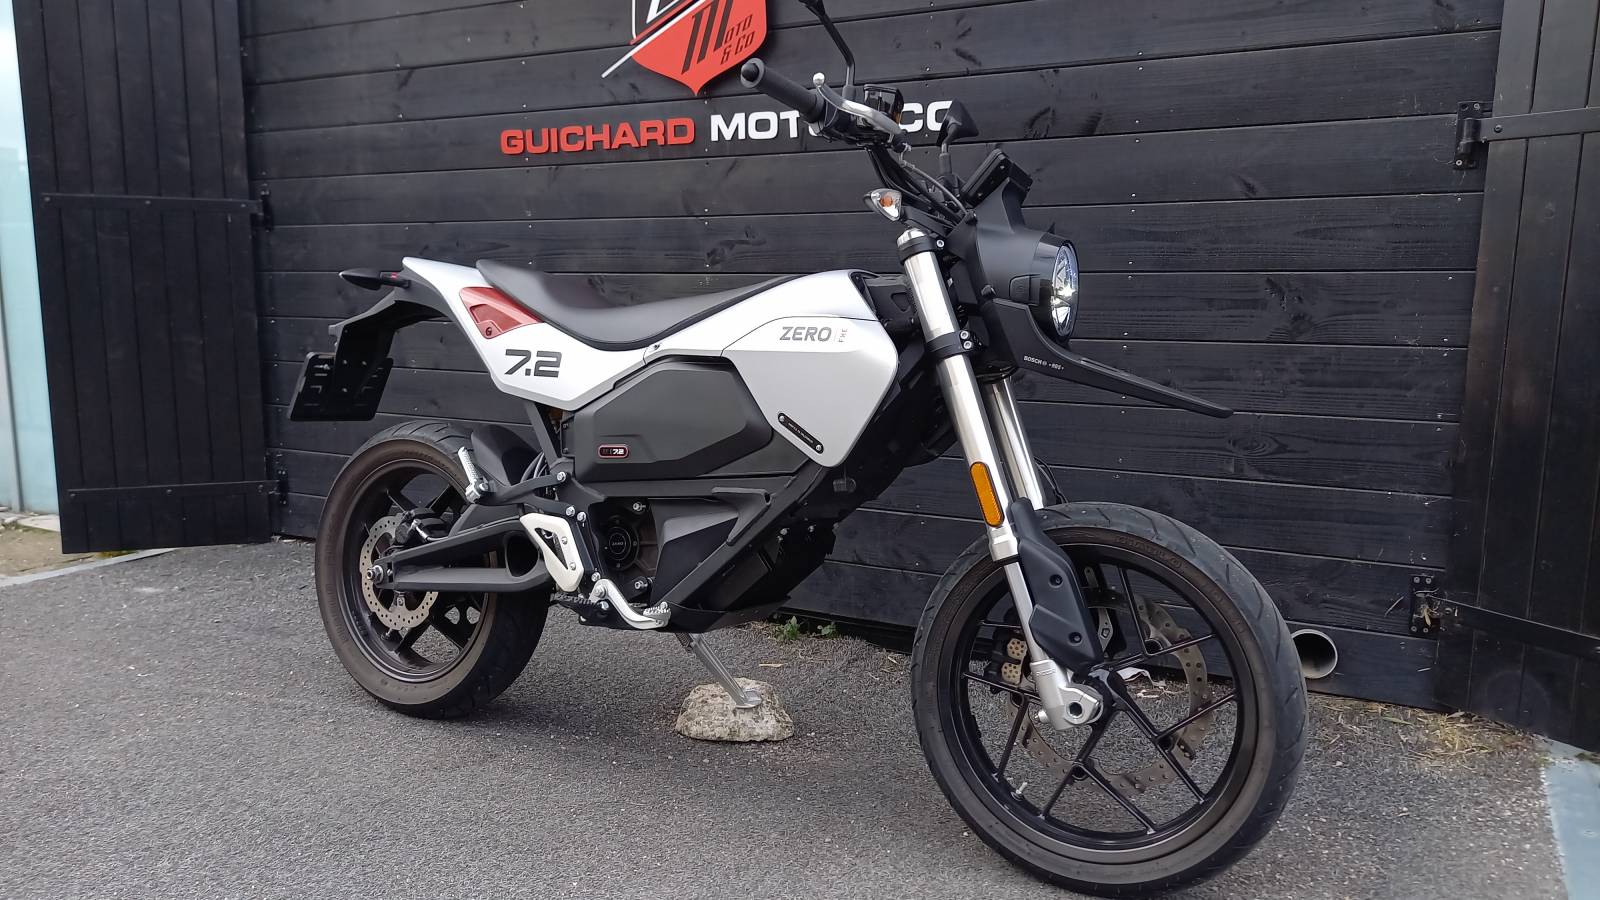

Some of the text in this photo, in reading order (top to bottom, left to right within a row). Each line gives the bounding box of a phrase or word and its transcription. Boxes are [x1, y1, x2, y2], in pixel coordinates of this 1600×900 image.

[500, 117, 695, 154] GUICHARD
[711, 110, 825, 142] MOT
[780, 326, 832, 342] ZERO
[504, 349, 562, 378] 7.2
